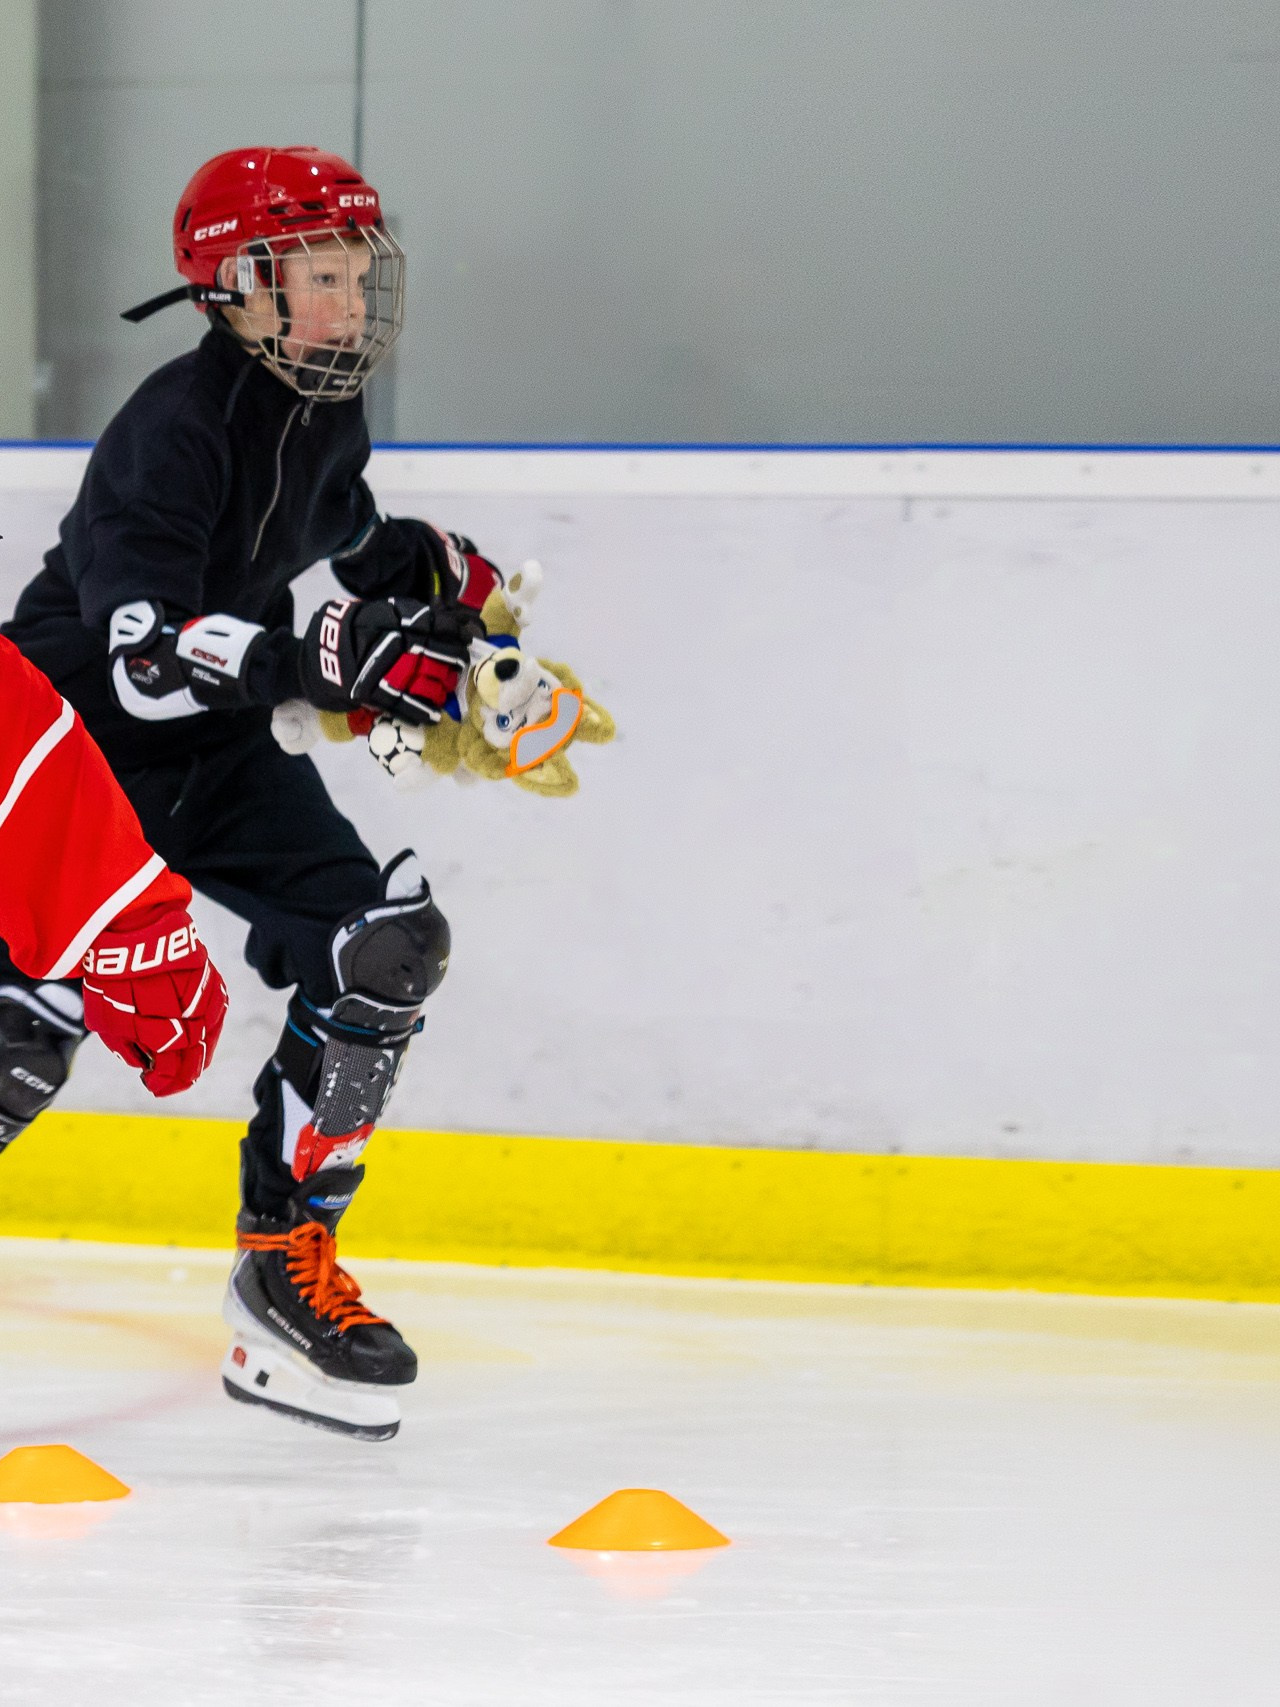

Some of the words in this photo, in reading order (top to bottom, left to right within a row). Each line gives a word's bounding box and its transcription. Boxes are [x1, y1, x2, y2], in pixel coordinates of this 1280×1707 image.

[339, 194, 375, 207] CCM
[194, 219, 238, 241] CCM
[11, 1066, 55, 1094] CCM
[267, 1306, 313, 1350] BAUER
